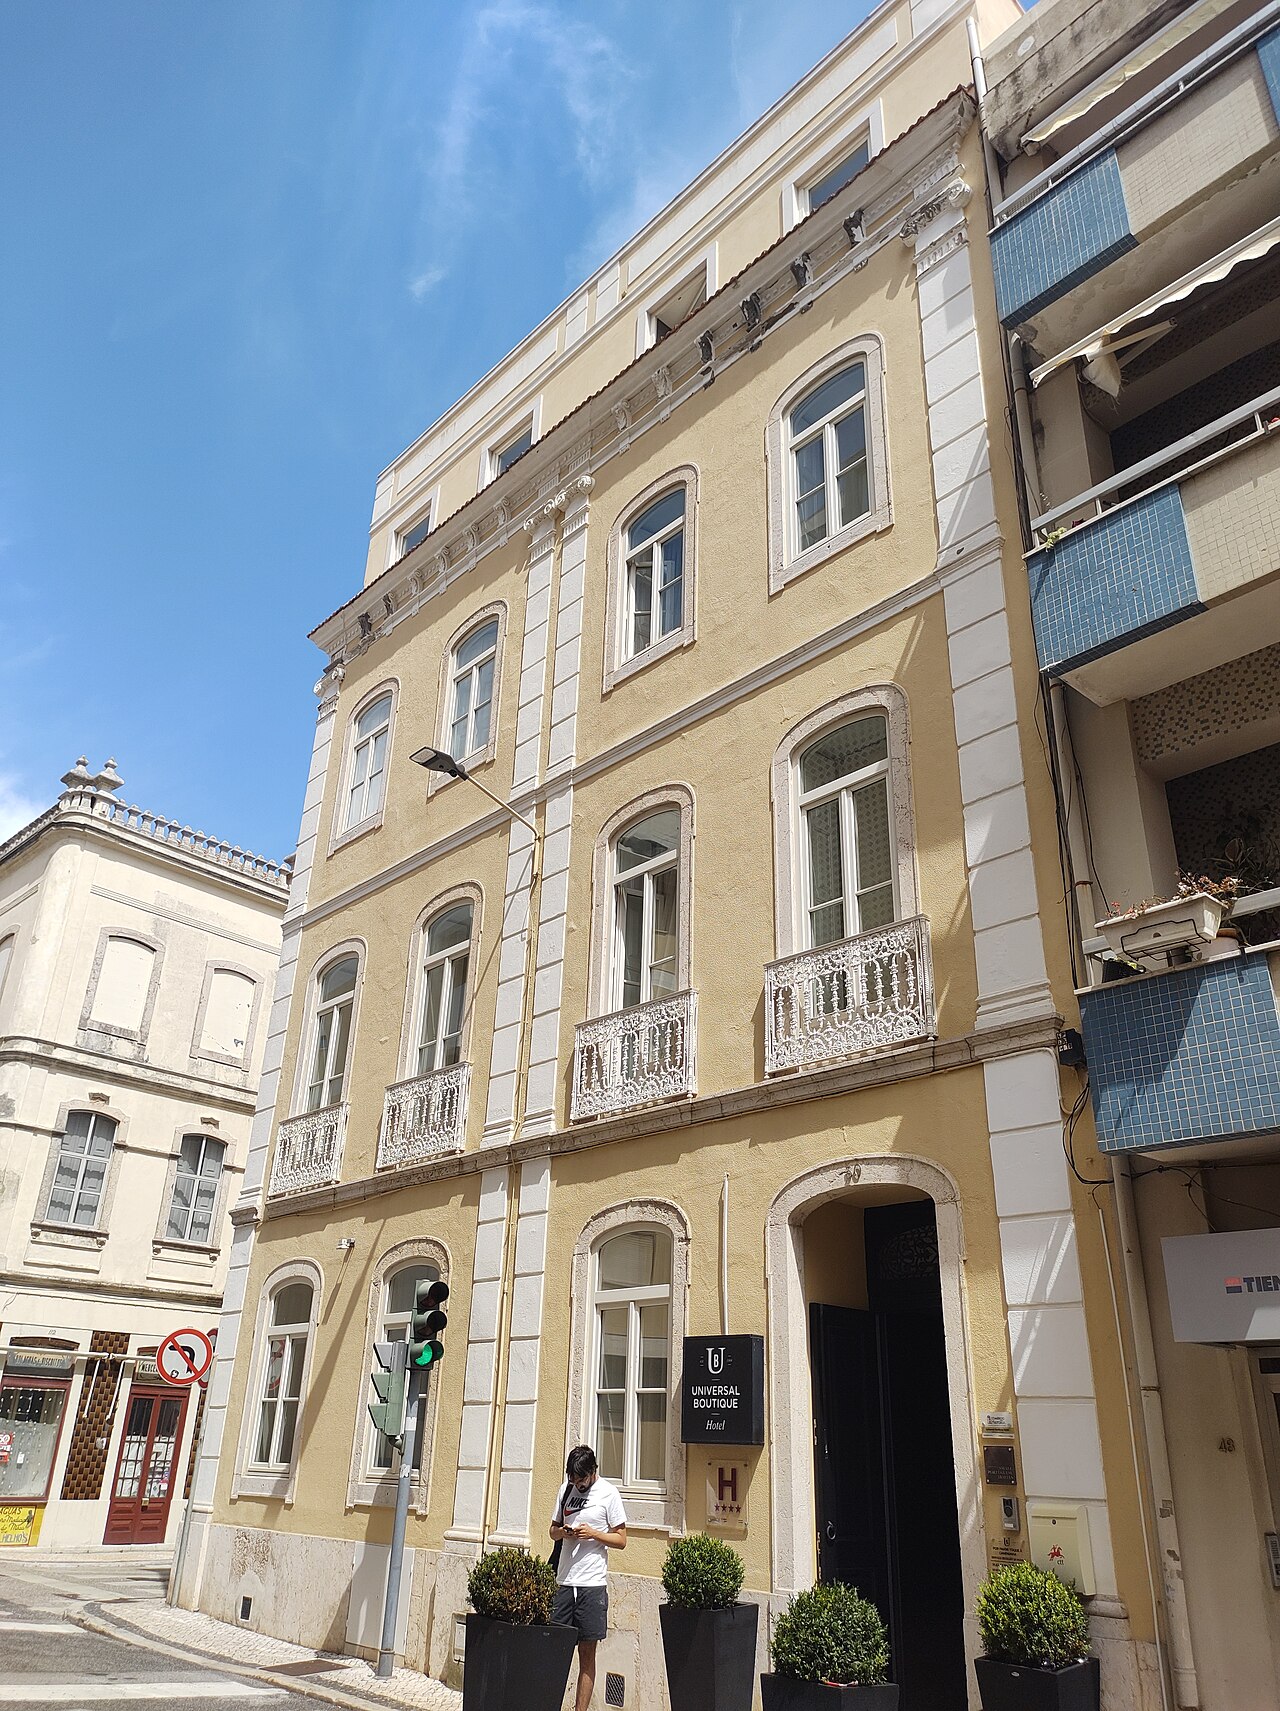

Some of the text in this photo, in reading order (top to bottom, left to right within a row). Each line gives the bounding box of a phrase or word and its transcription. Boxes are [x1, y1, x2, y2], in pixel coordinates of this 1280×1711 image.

[691, 1385, 740, 1396] UNIVERSAL
[693, 1398, 738, 1409] BOUTIQUE
[706, 1420, 726, 1430] Hotel
[718, 1467, 737, 1501] H
[567, 1497, 589, 1508] NIKE
